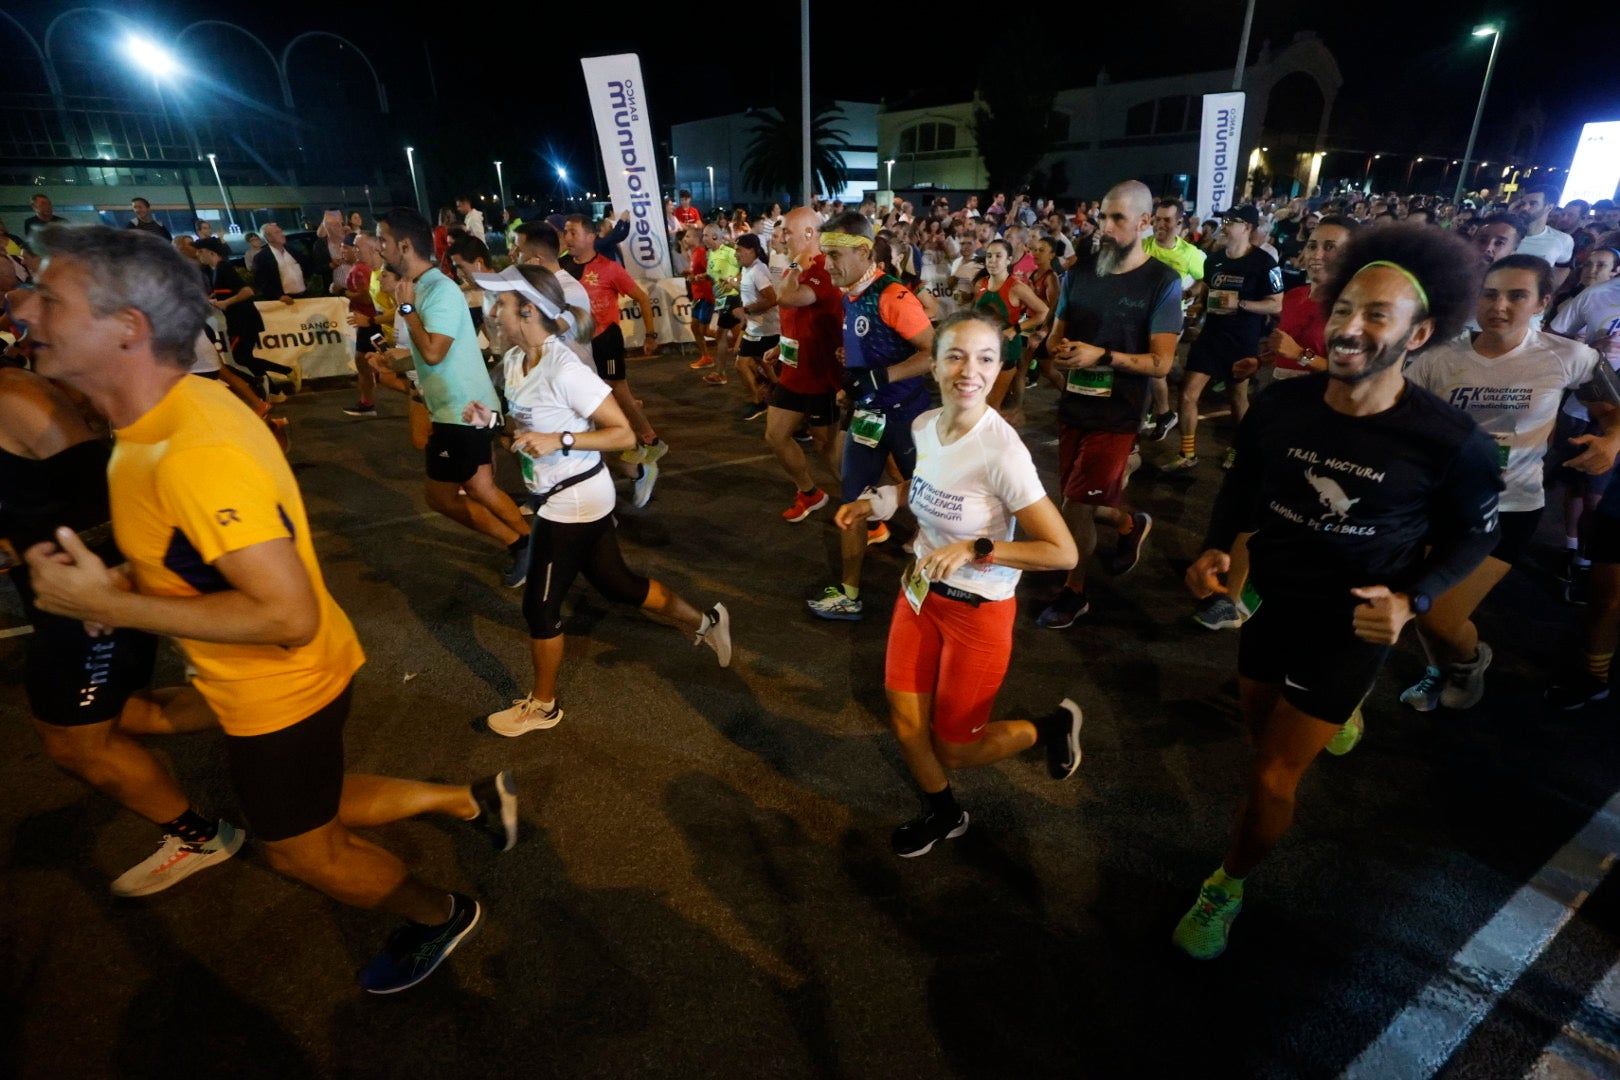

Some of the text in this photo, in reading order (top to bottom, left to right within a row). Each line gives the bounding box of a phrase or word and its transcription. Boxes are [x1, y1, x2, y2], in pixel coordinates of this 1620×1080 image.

[300, 320, 338, 331] BANCO
[1483, 386, 1533, 394] Nocturna
[1287, 447, 1386, 483] TRAIL NOCTURN
[1307, 518, 1321, 531] DE
[1324, 523, 1376, 535] CABRES
